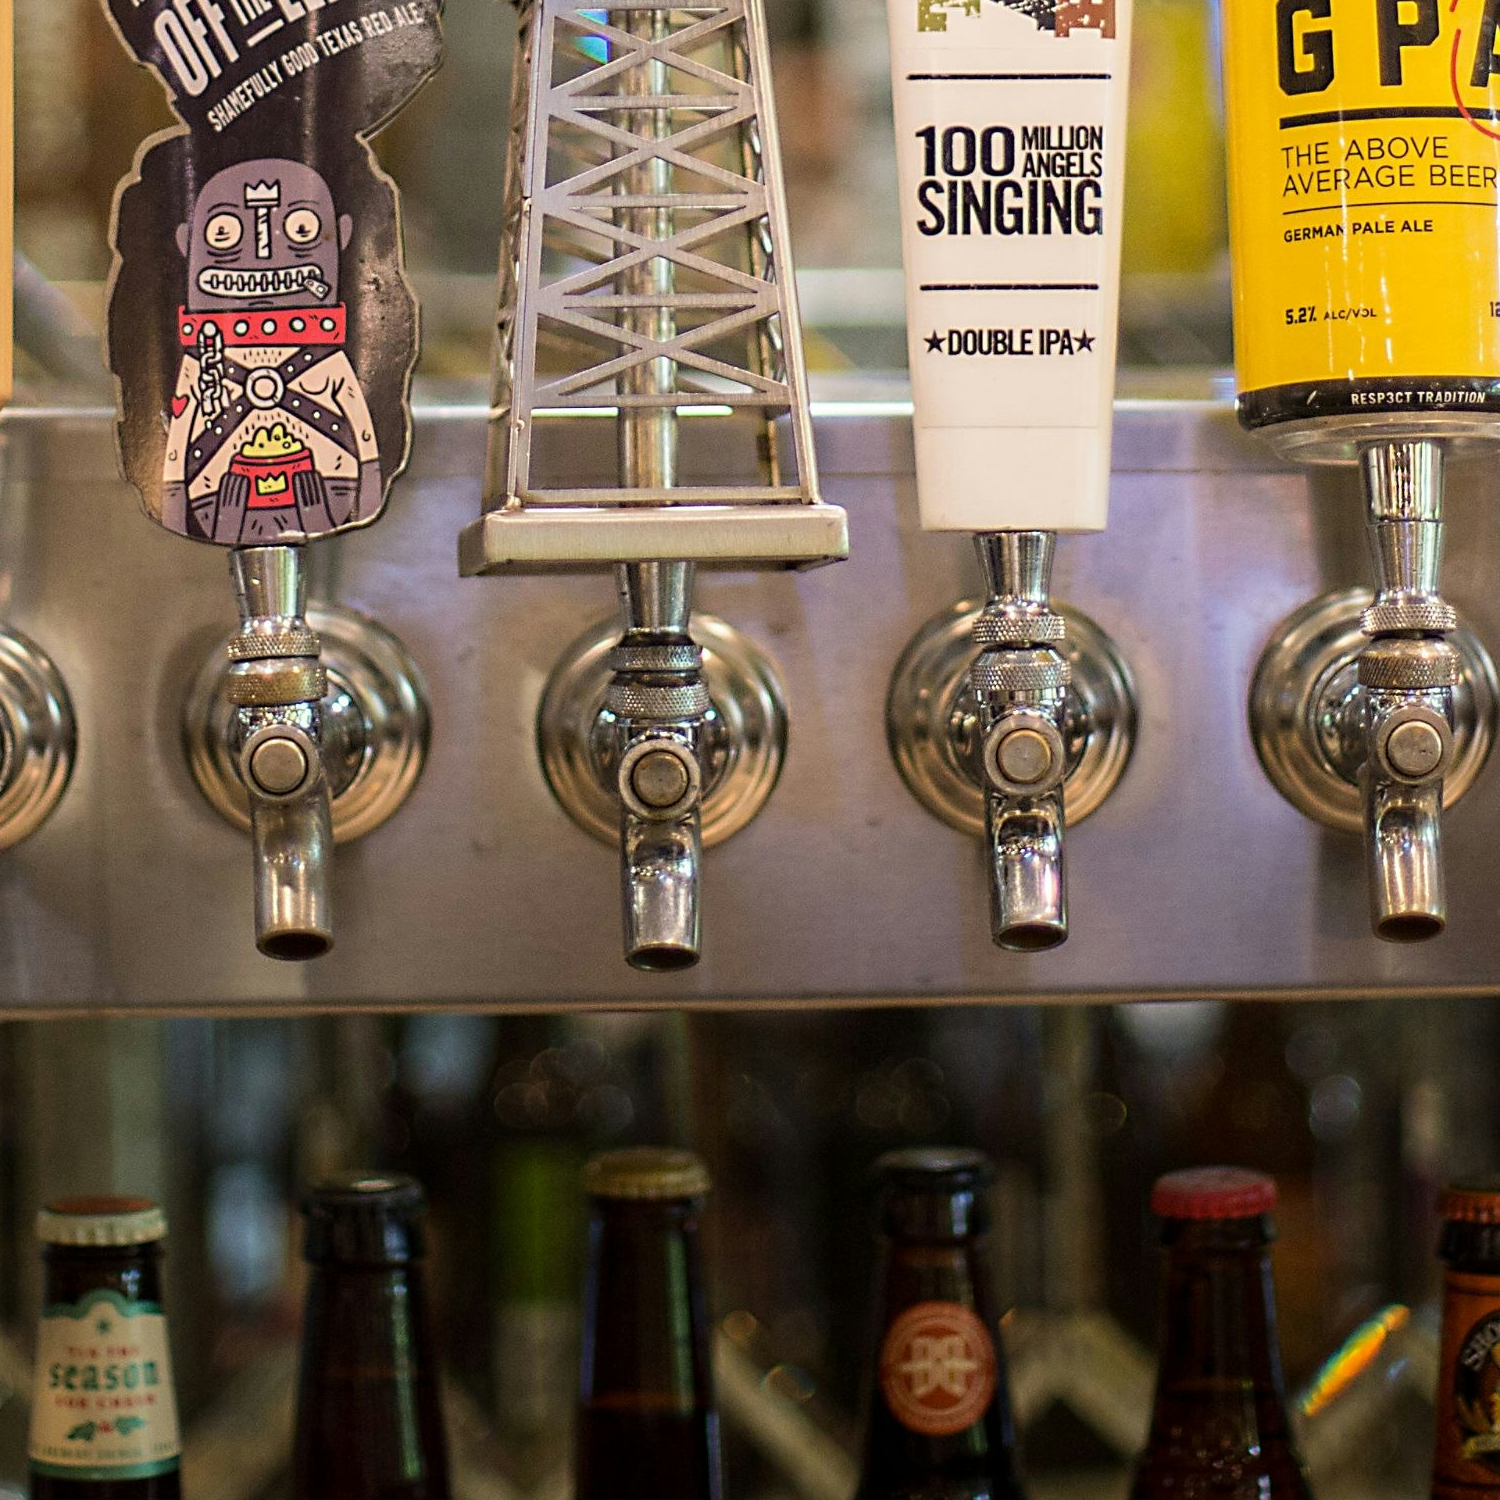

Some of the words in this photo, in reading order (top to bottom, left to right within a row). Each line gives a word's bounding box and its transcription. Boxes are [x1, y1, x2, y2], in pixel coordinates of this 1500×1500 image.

[207, 61, 285, 133] SHAMEFULLY
[283, 40, 320, 77] GOOD
[316, 21, 363, 58] TEXAS
[362, 10, 393, 39] RED
[393, 2, 424, 29] ALE
[915, 125, 1015, 177] 100
[1021, 125, 1104, 151] MILLION
[1021, 152, 1104, 178] ANGELS
[1281, 141, 1330, 169] THE
[1344, 136, 1450, 162] ABOVE
[1282, 164, 1416, 197] AVERAGE
[1430, 165, 1500, 190] BEER
[916, 179, 1104, 236] SINGING
[1283, 223, 1346, 243] GERMAN
[1352, 221, 1396, 236] PALE
[1400, 219, 1434, 233] ALE
[1285, 306, 1318, 325] 5.2%
[1323, 307, 1378, 322] ALC/VOL
[948, 329, 1034, 357] DOUBLE
[1039, 329, 1075, 356] IPA
[1350, 390, 1412, 405] RESP3CT
[1418, 390, 1487, 405] TRADITION
